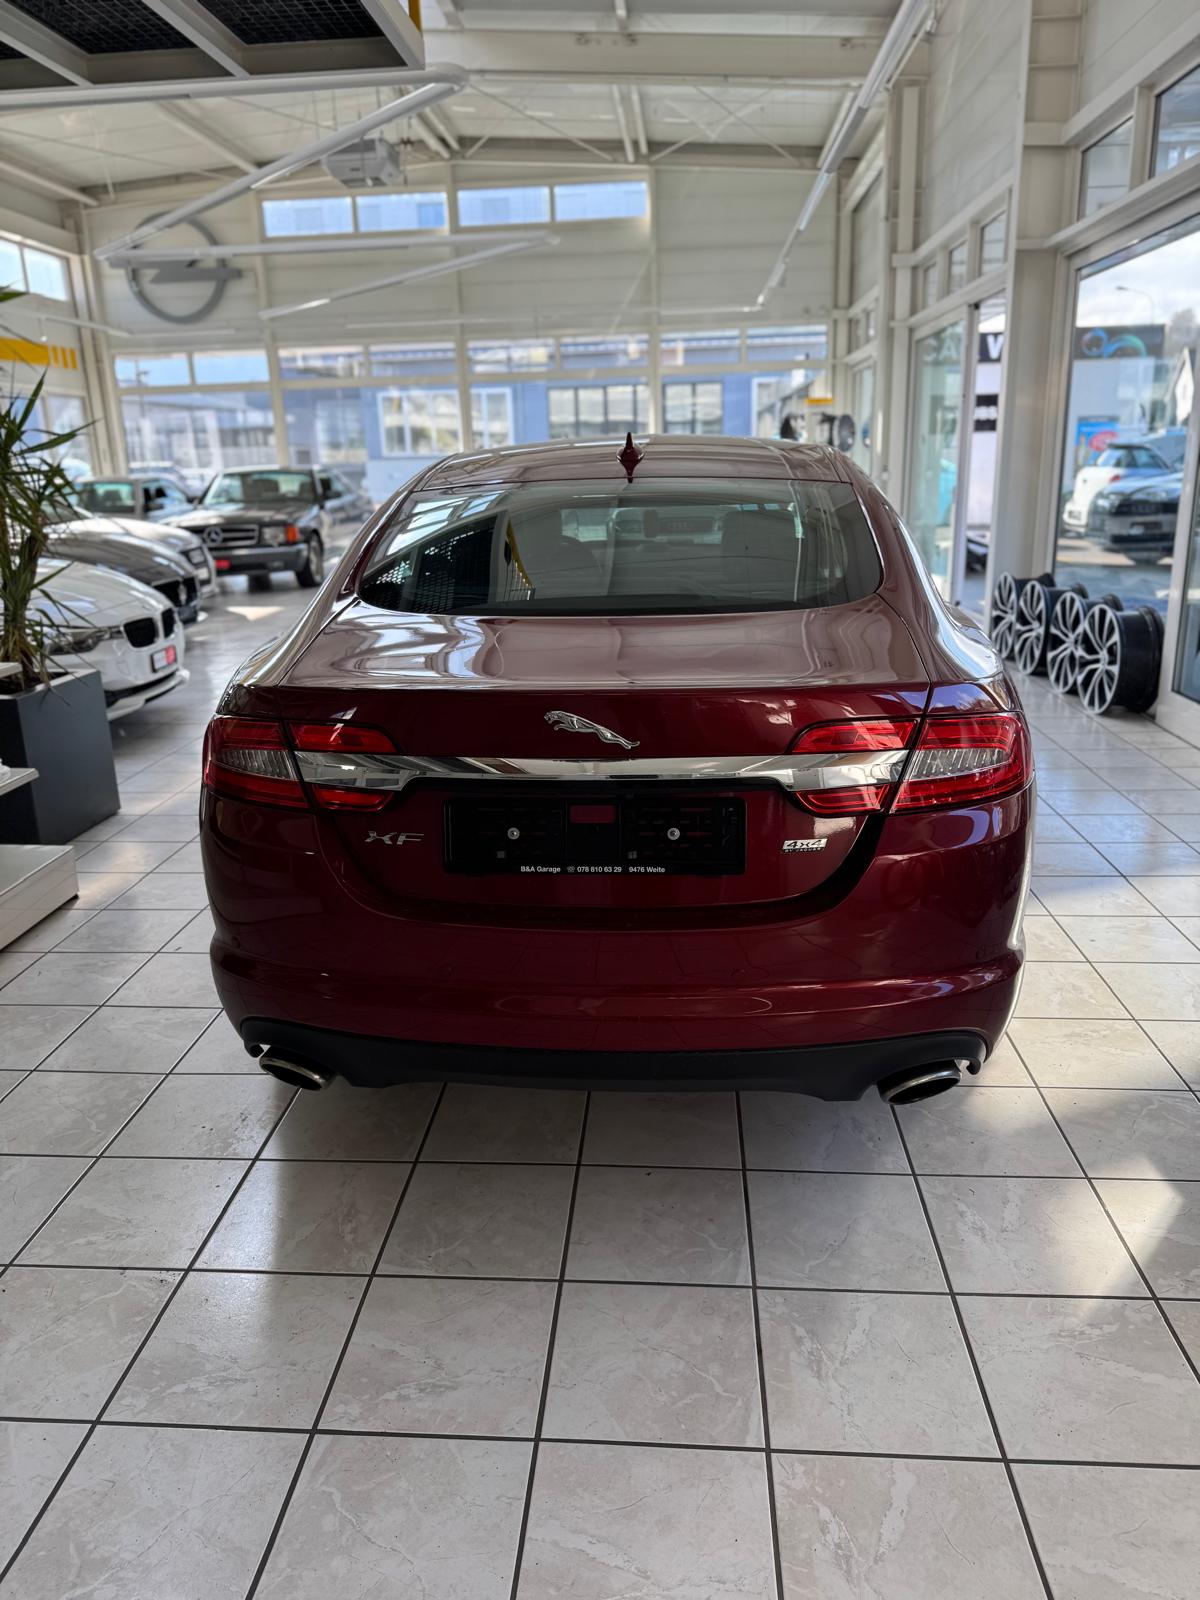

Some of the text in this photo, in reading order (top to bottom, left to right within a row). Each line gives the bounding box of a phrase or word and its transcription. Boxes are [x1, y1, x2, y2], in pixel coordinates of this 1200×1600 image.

[364, 830, 425, 845] XF
[786, 839, 822, 848] 4x4
[520, 865, 666, 873] B&A Garage 078 810 63 29 9476 Weite
